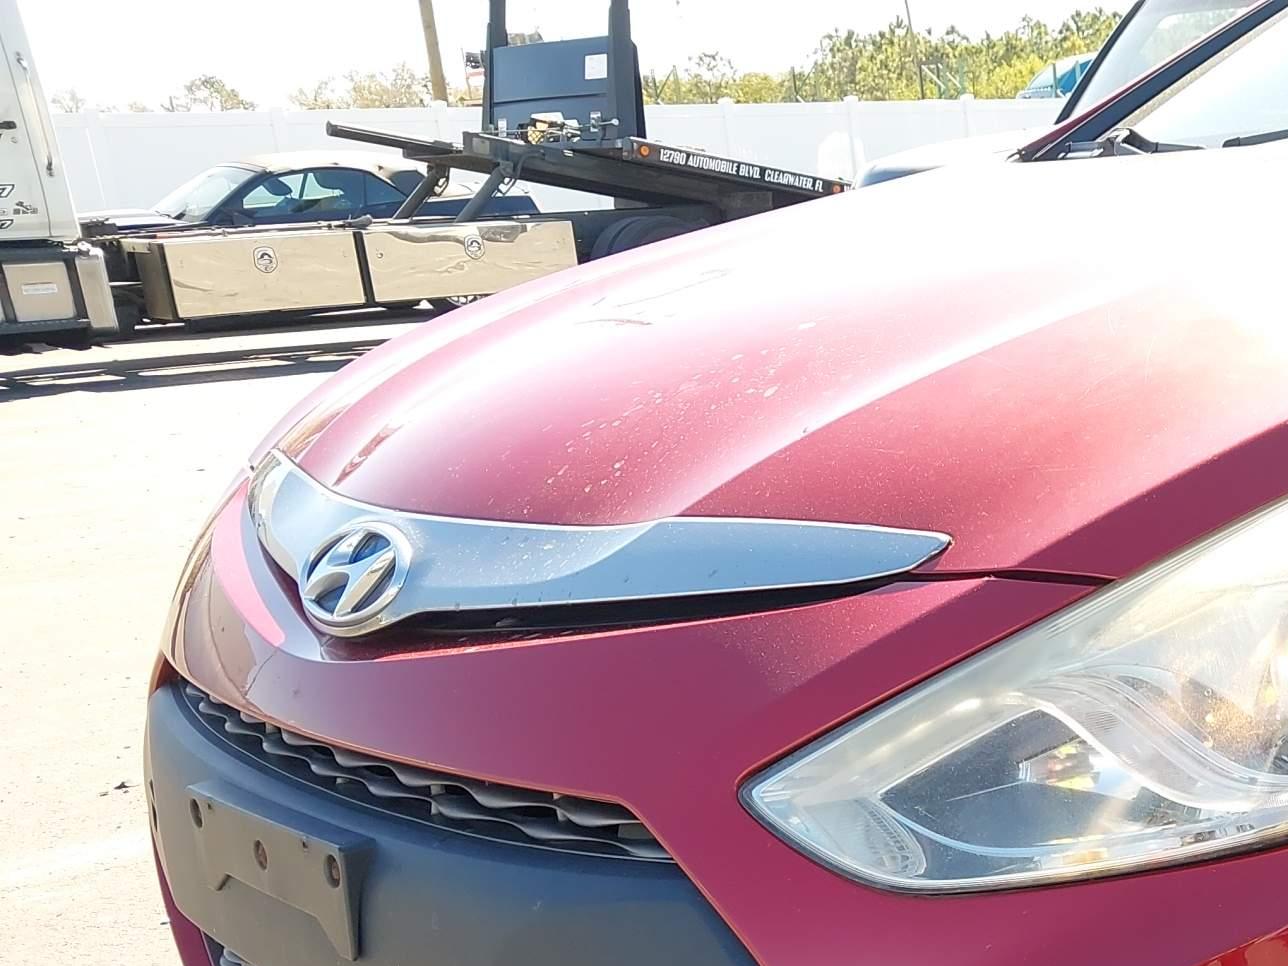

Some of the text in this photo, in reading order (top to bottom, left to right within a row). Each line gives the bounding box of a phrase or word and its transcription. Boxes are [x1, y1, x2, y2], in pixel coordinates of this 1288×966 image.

[659, 148, 686, 165] 12790
[687, 155, 738, 175] AUTOMOBILE
[814, 180, 824, 193] FL
